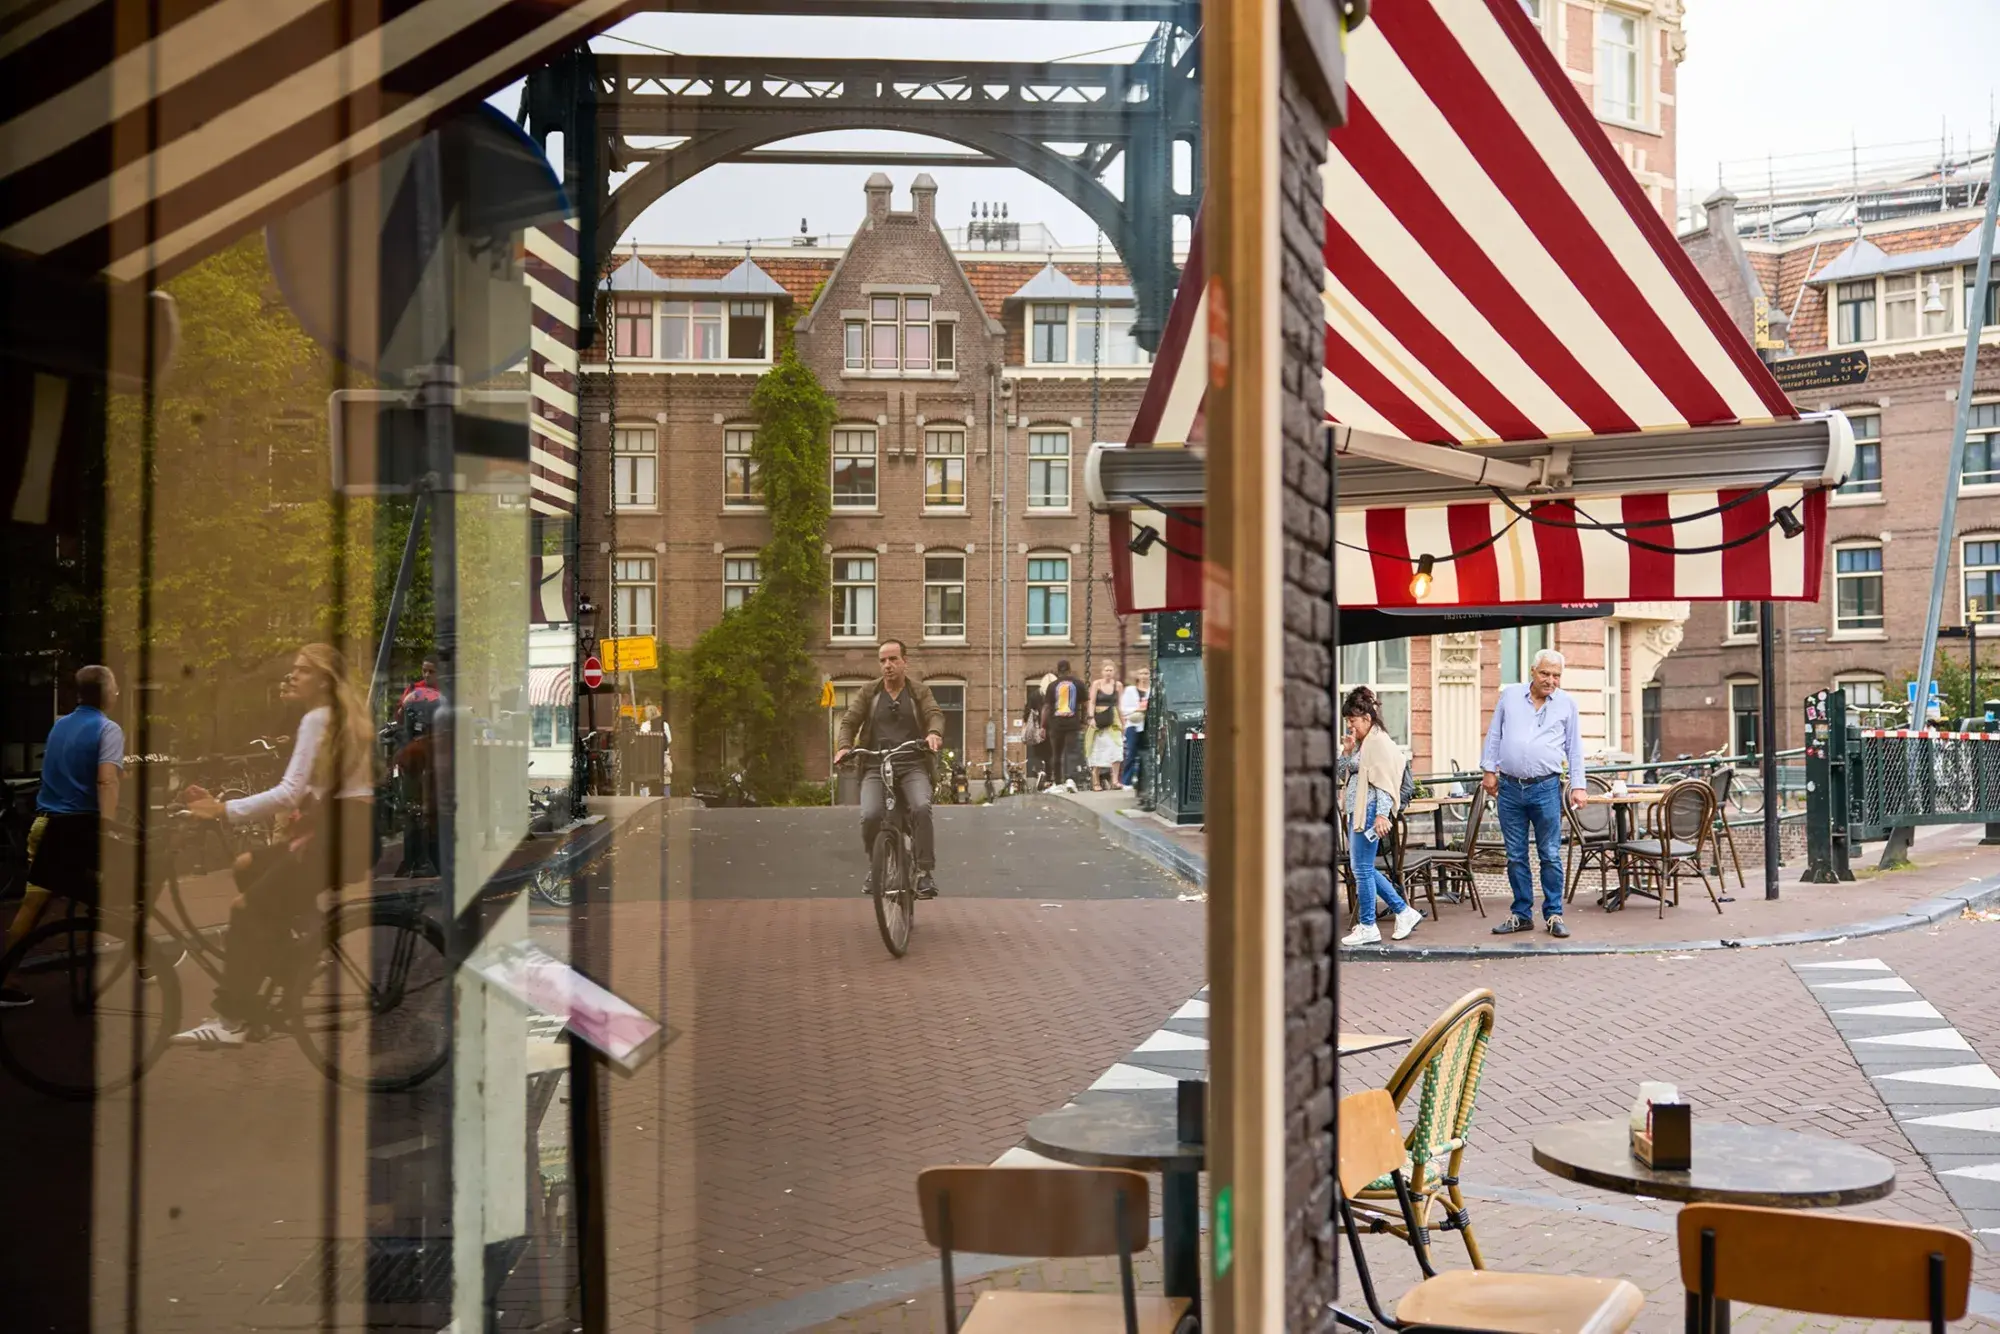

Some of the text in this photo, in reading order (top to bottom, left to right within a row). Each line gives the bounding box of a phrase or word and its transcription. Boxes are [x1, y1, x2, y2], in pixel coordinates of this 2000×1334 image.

[1786, 360, 1823, 371] Zuiderkerk
[1776, 369, 1817, 380] Nieuwmarkt
[1805, 376, 1831, 386] Station
